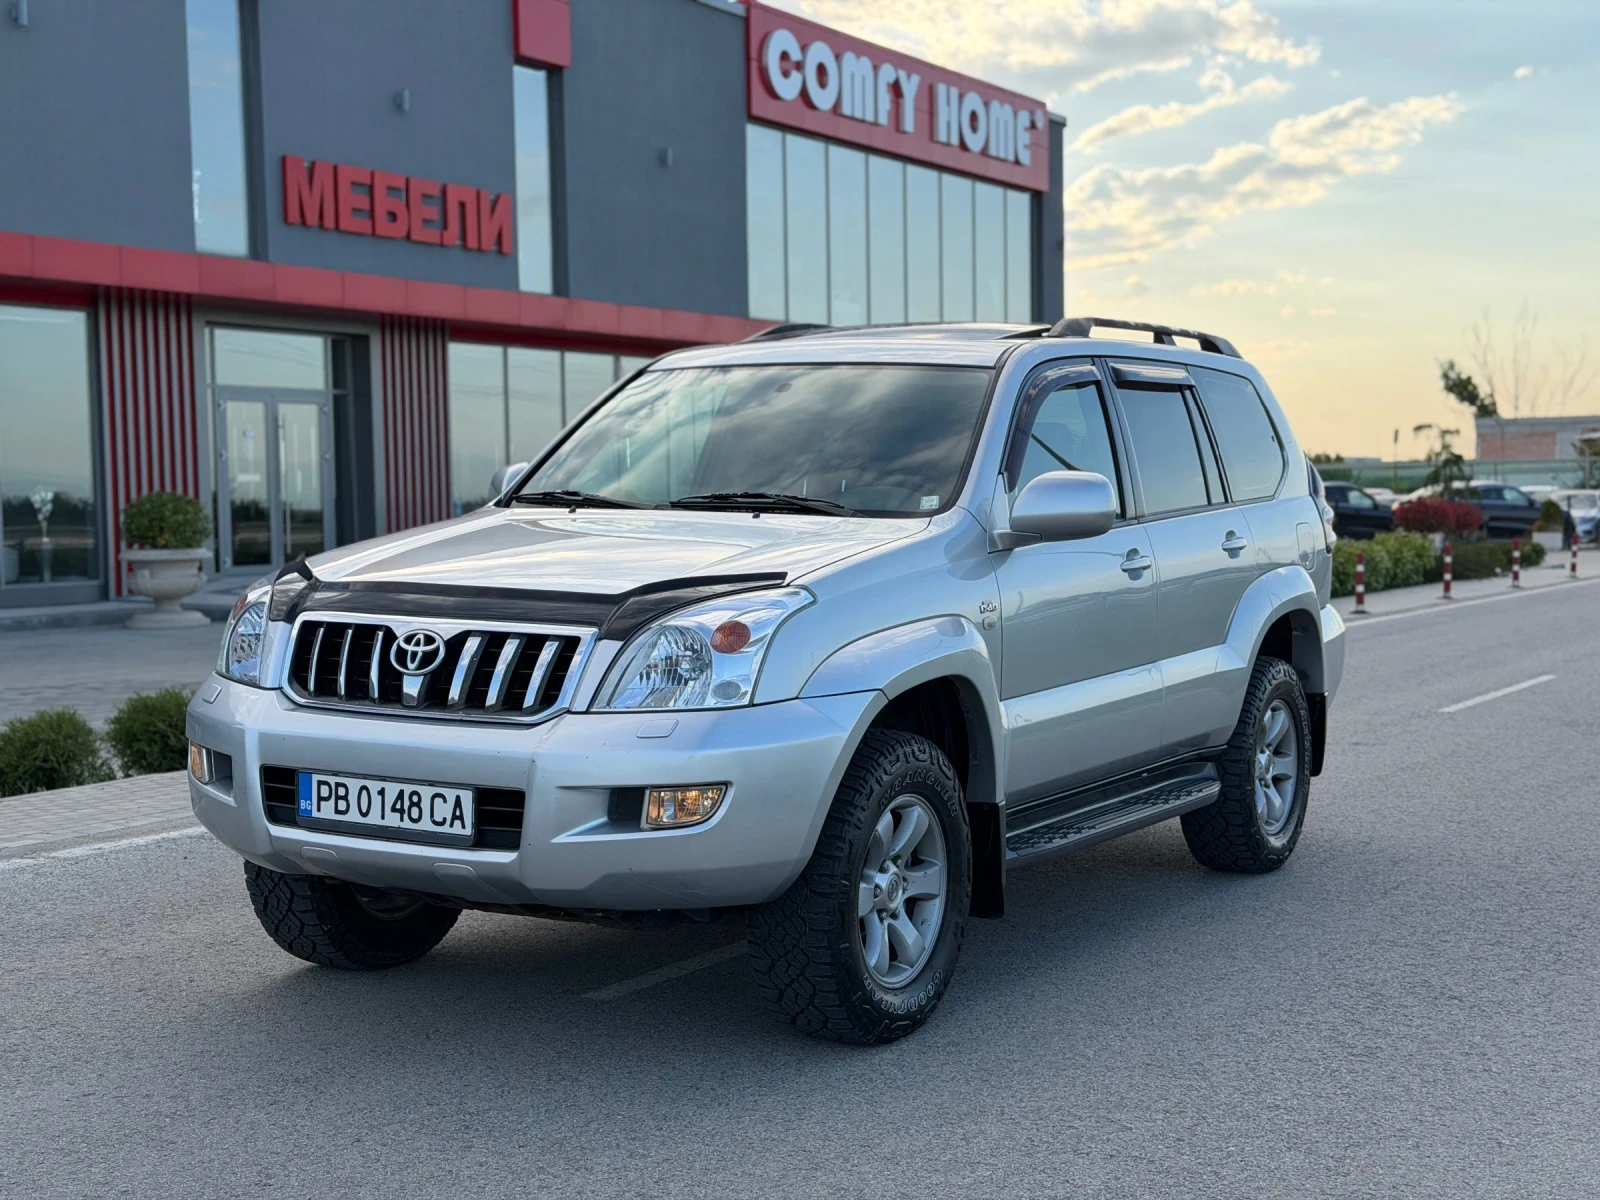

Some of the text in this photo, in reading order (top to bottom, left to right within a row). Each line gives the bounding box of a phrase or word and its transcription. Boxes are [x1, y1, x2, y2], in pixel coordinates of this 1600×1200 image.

[764, 28, 1030, 167] COMFY HOME
[282, 154, 513, 256] МЕБЕЛИ
[300, 799, 312, 811] BG
[316, 779, 466, 830] PB 0148 CA
[880, 769, 958, 817] WRANGLER
